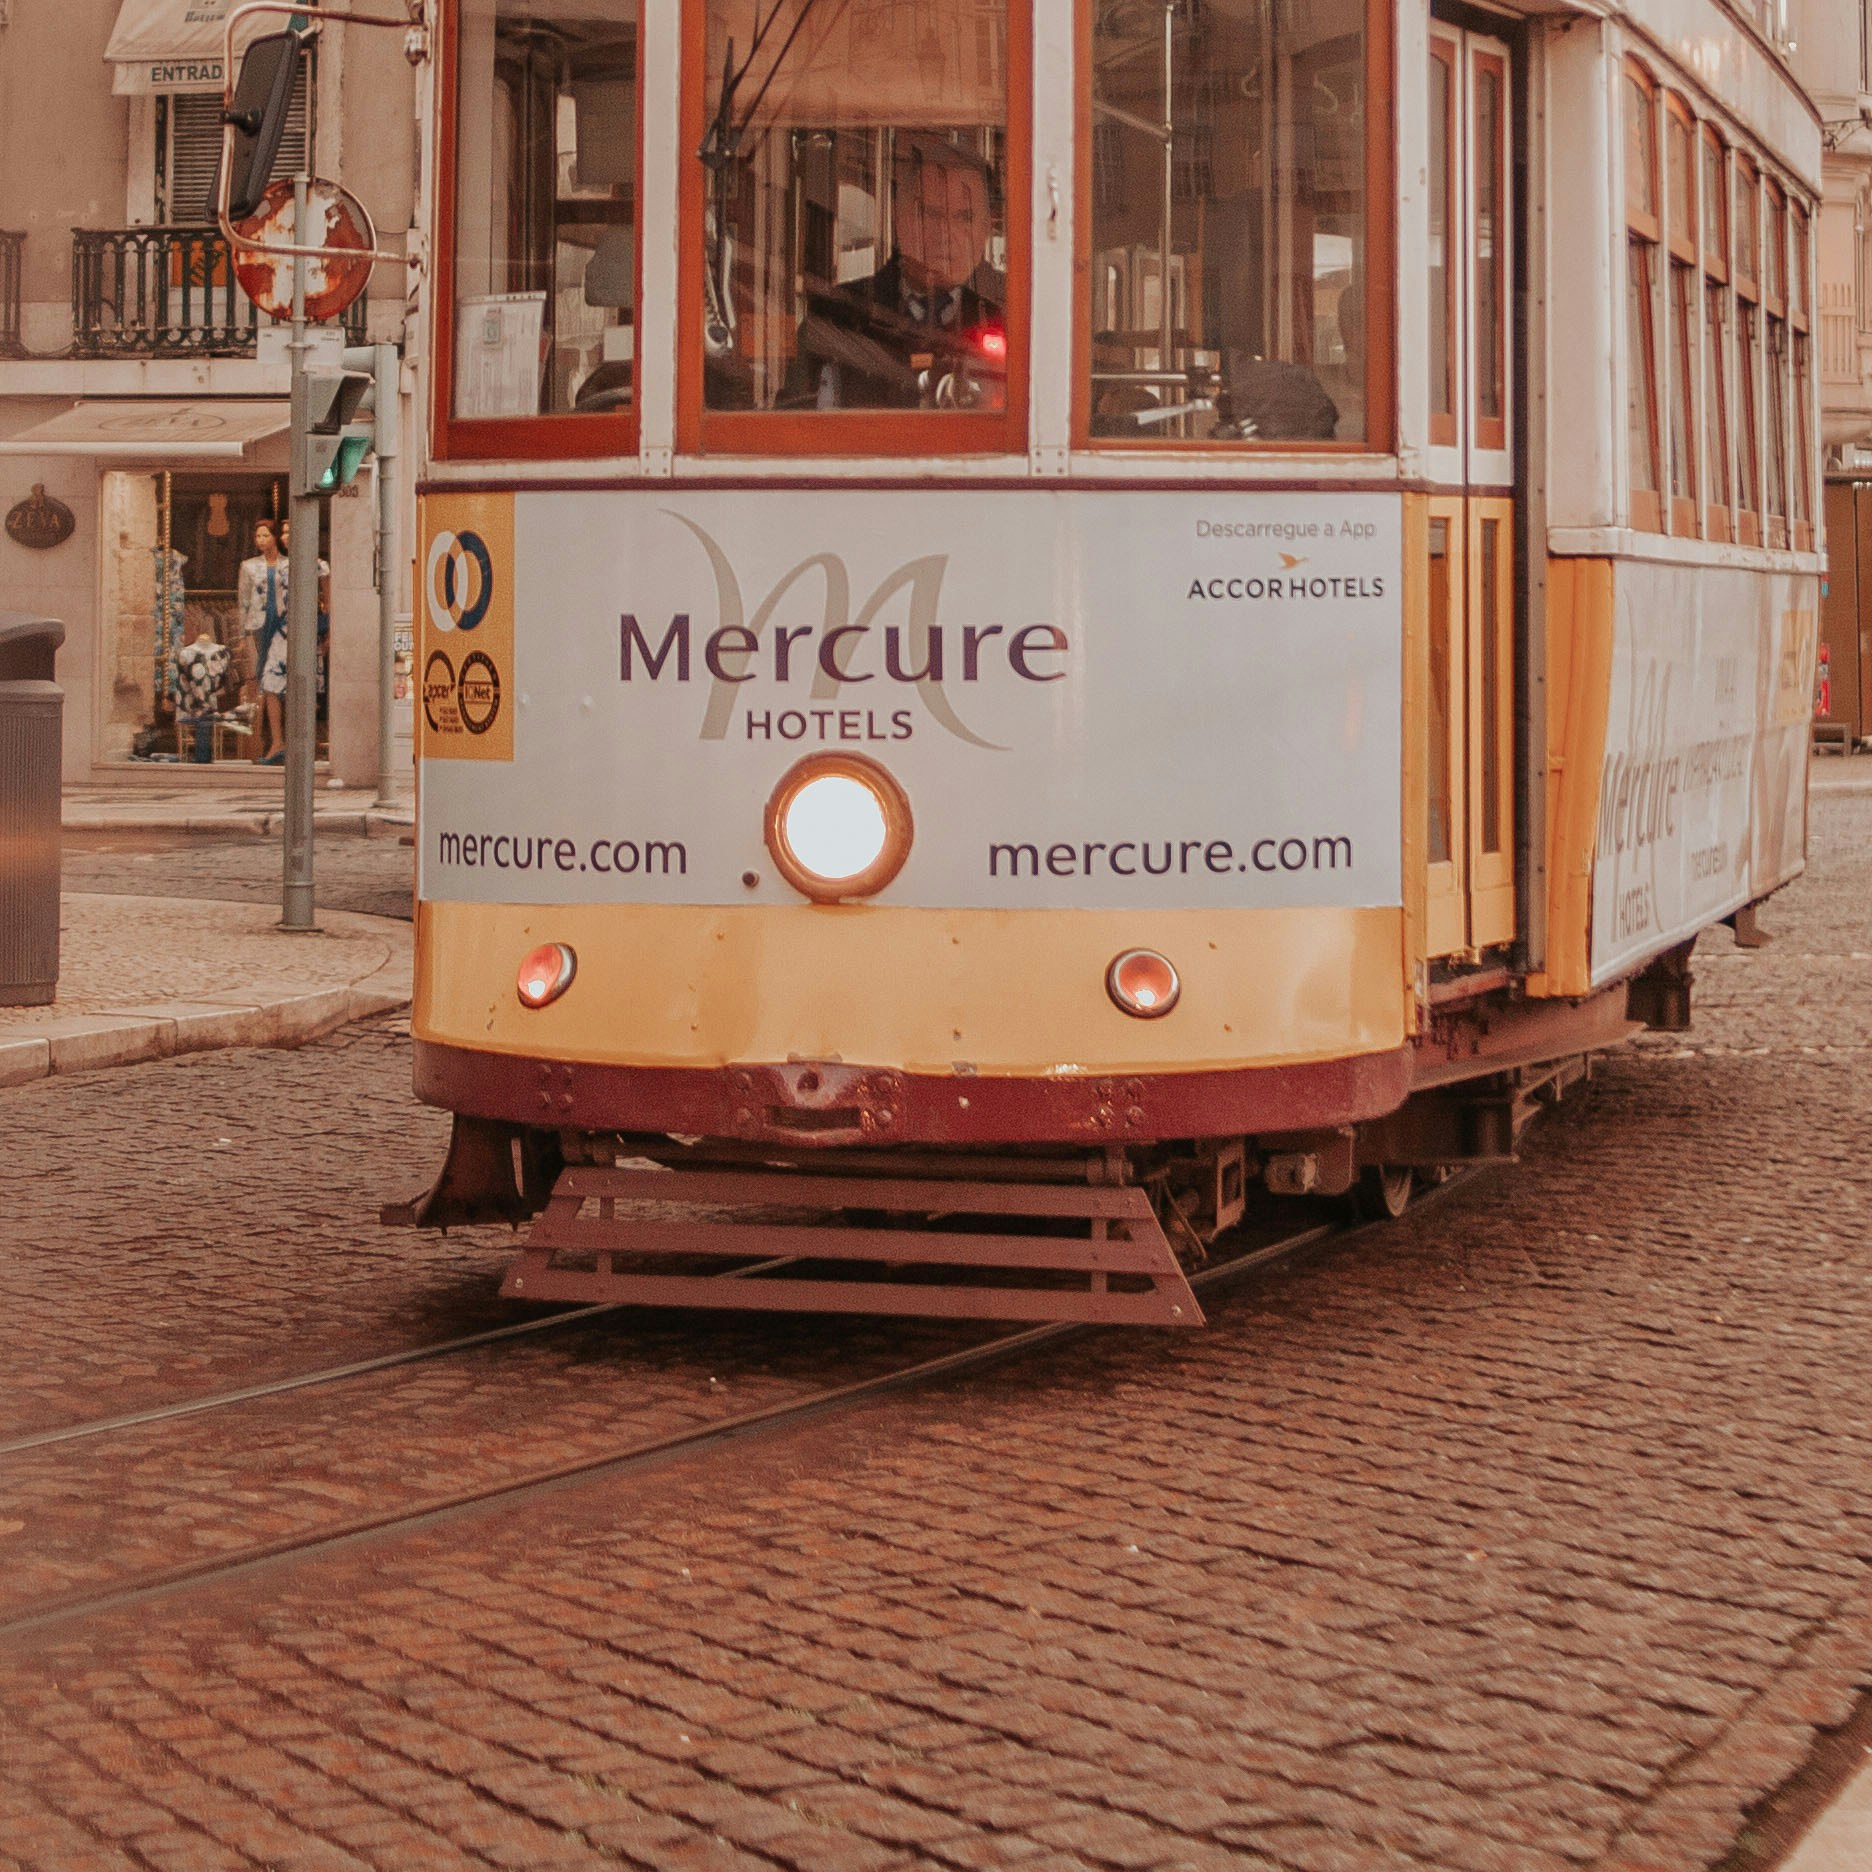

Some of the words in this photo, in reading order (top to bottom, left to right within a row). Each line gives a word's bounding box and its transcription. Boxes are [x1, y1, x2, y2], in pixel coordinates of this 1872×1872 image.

[151, 64, 224, 82] ENTRAD
[1195, 519, 1318, 540] Descarregue
[1323, 523, 1334, 537] a
[1339, 519, 1376, 541] App
[1187, 578, 1283, 599] ACCOR
[1288, 577, 1385, 599] HOTELS
[619, 613, 1069, 683] Mercure
[745, 709, 914, 740] HOTELS
[439, 831, 687, 874] mercure.com
[989, 835, 1353, 876] mercure.com
